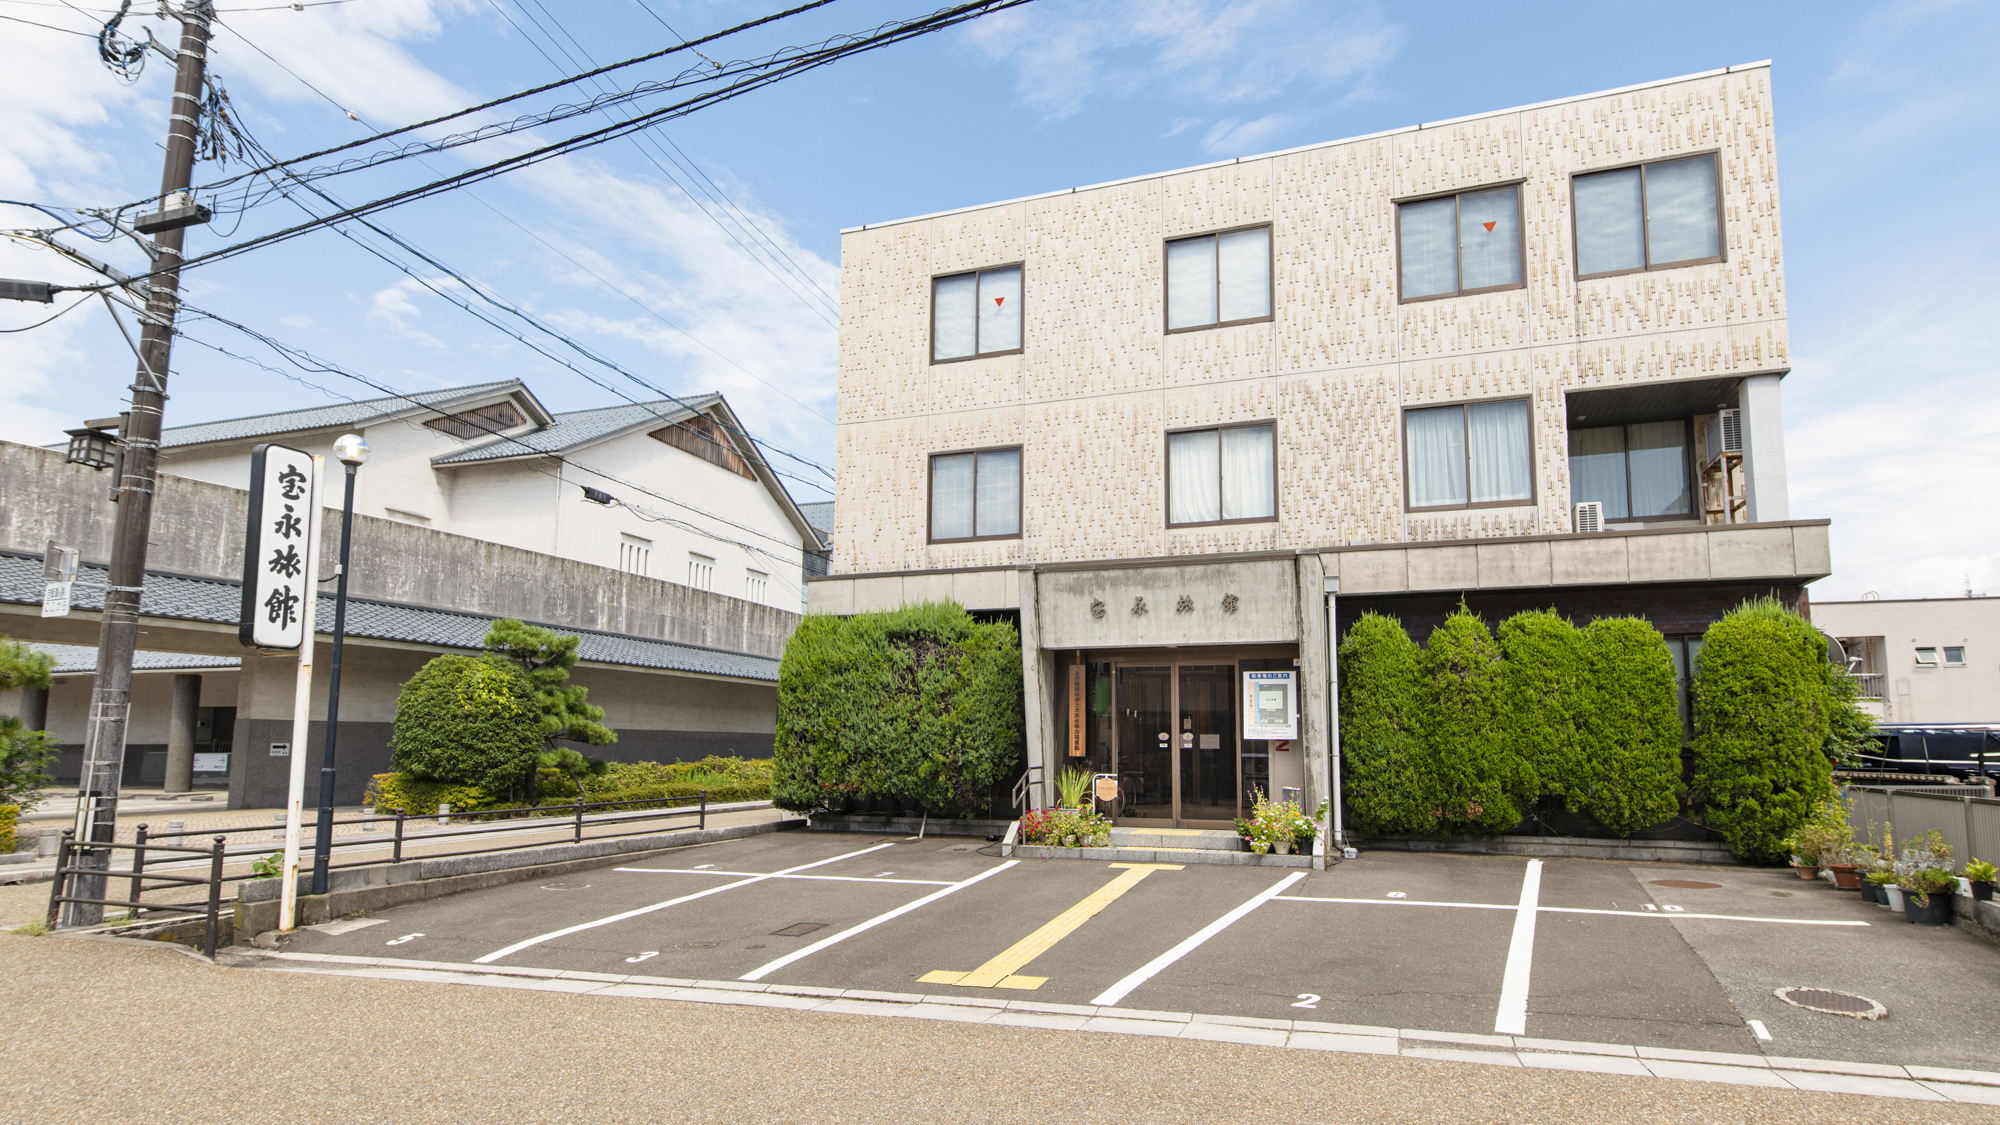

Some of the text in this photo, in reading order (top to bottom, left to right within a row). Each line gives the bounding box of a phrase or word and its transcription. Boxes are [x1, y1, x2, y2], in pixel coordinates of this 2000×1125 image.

[264, 463, 307, 631] 宝永旅館
[385, 933, 426, 945] 5
[625, 951, 660, 963] 3
[1291, 993, 1321, 1009] 2
